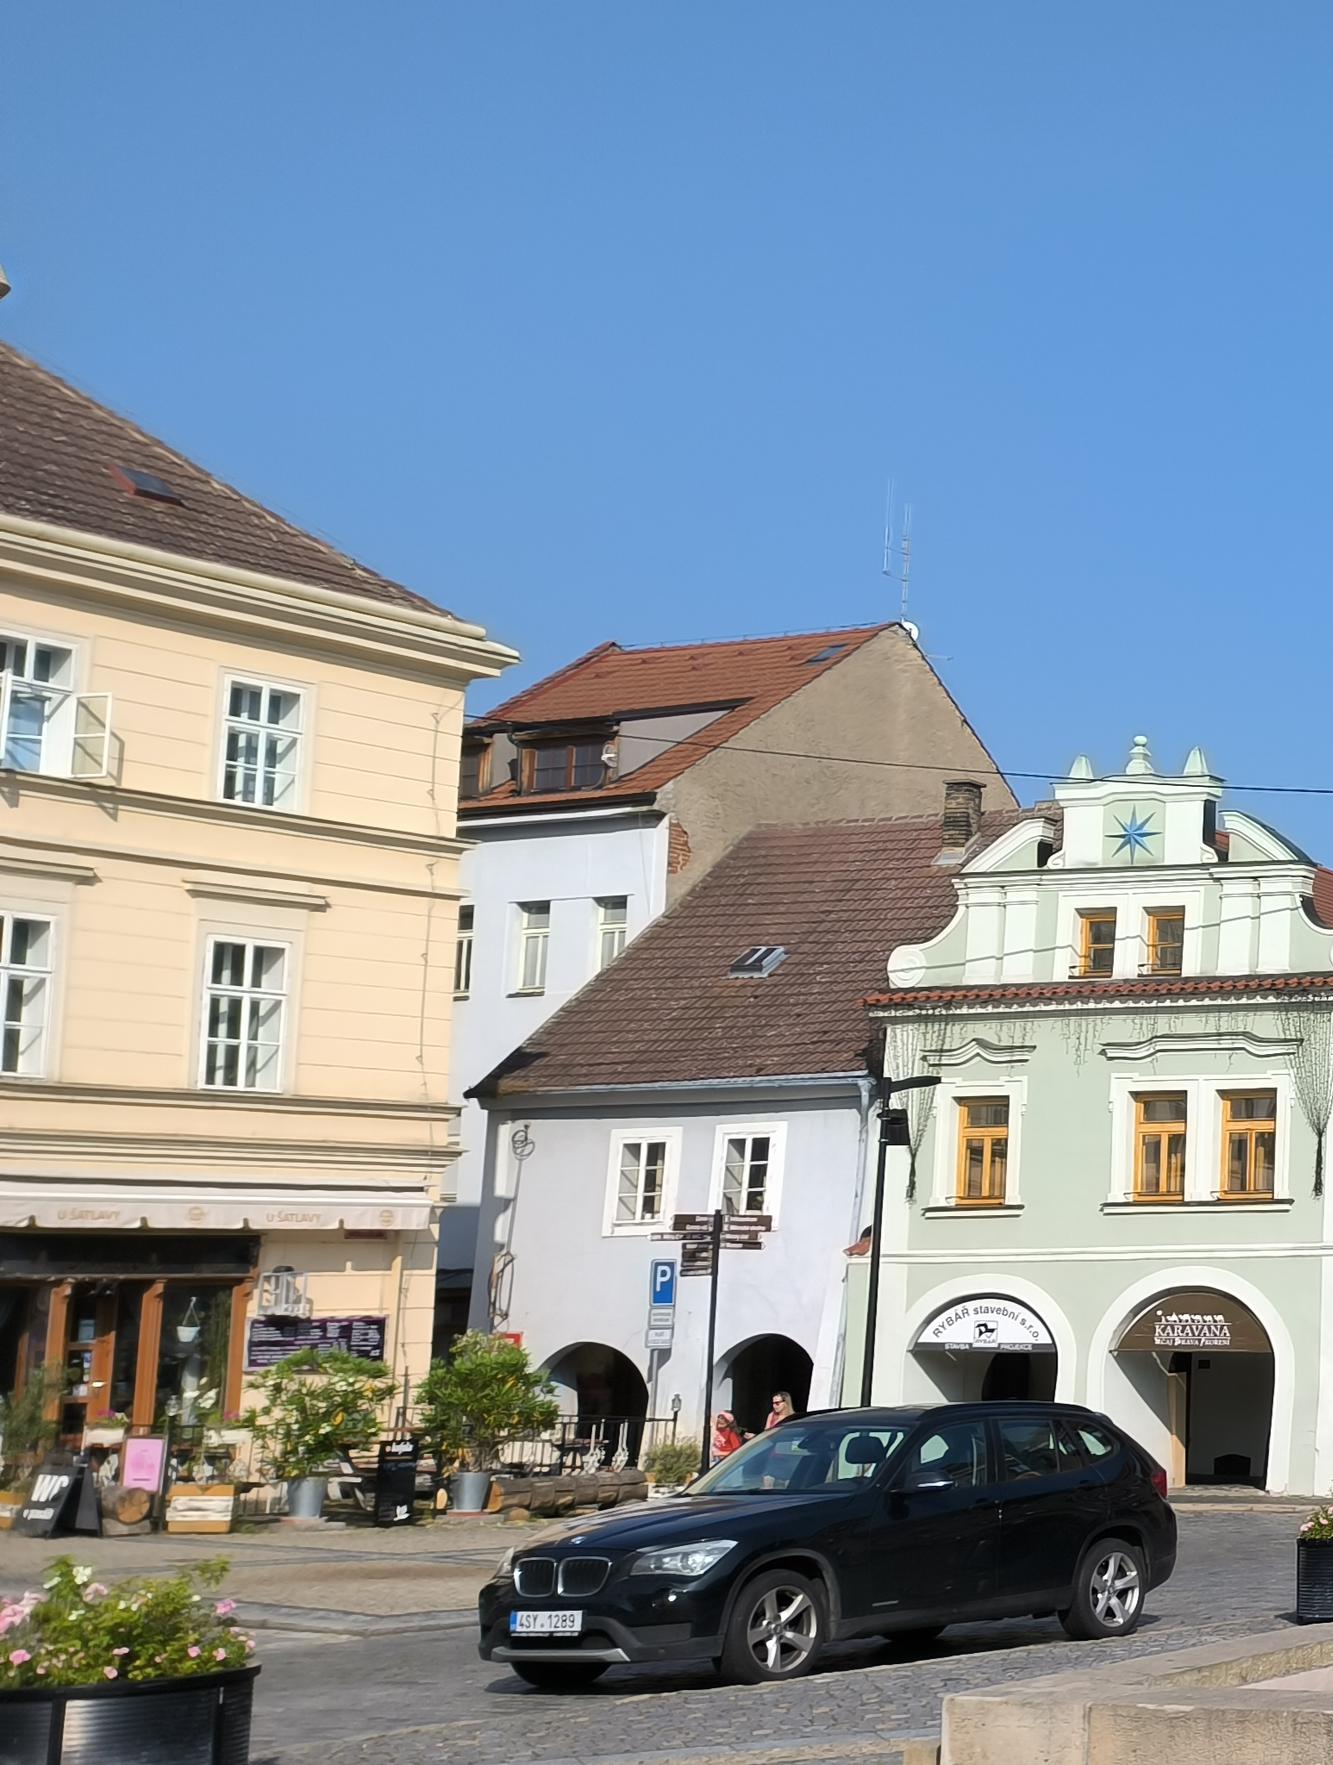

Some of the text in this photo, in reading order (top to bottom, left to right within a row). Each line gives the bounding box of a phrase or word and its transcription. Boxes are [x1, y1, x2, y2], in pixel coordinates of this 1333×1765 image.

[656, 1265, 671, 1292] P
[973, 1305, 1021, 1321] stavební
[1019, 1317, 1039, 1342] s.r.o.
[1155, 1325, 1230, 1337] KARAVANA
[547, 1613, 575, 1629] 1289
